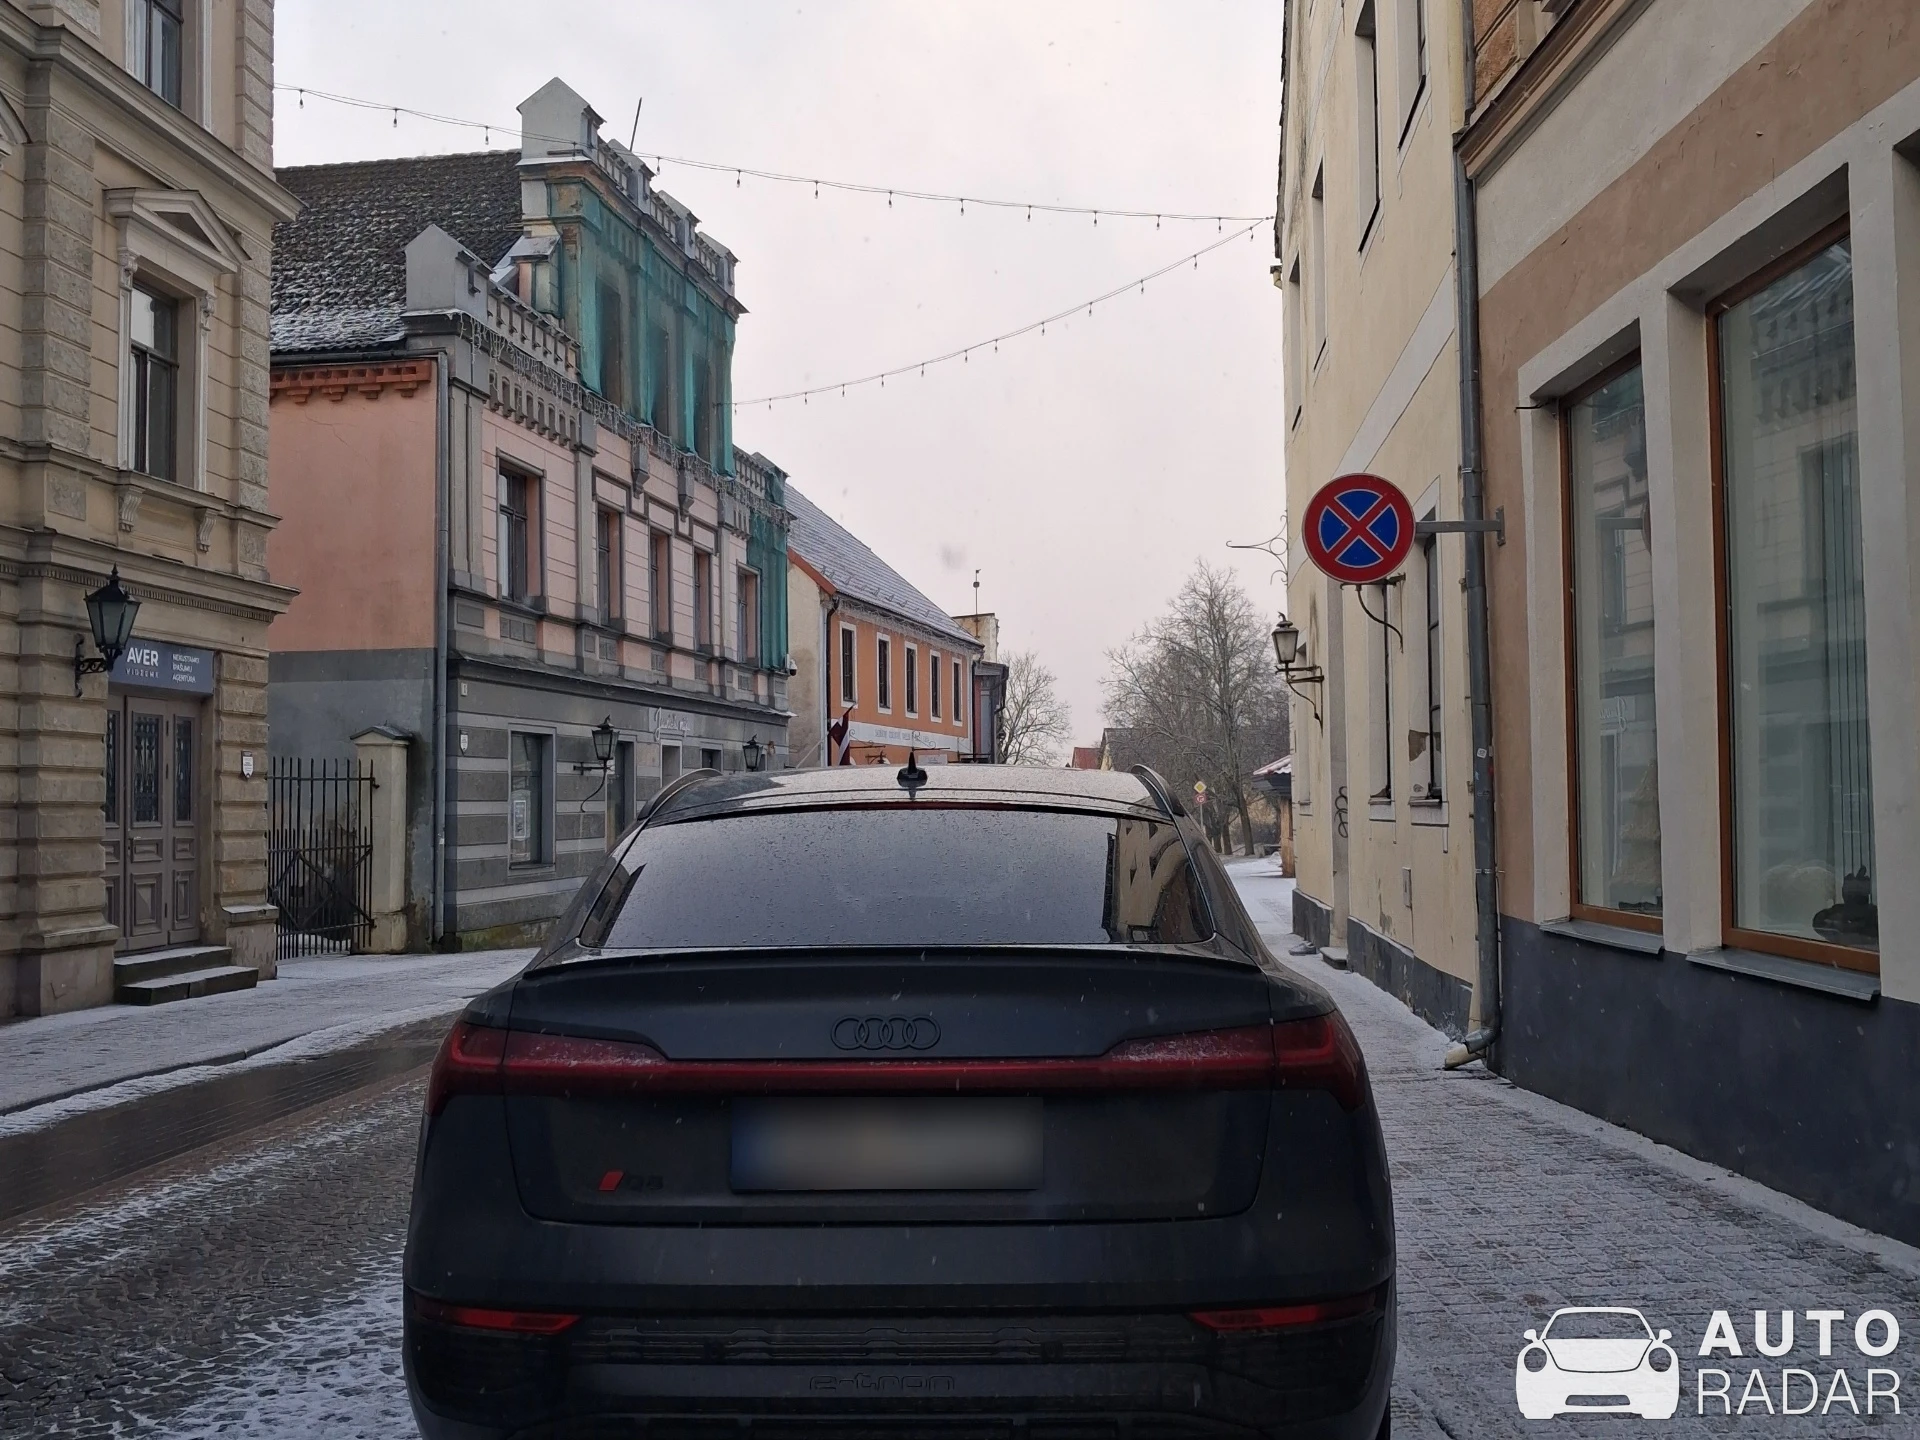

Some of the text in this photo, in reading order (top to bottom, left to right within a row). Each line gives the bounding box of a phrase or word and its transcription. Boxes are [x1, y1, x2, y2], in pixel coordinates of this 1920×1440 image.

[127, 647, 159, 666] AVER
[126, 668, 160, 679] VIDZEME
[809, 1372, 955, 1391] e-tron
